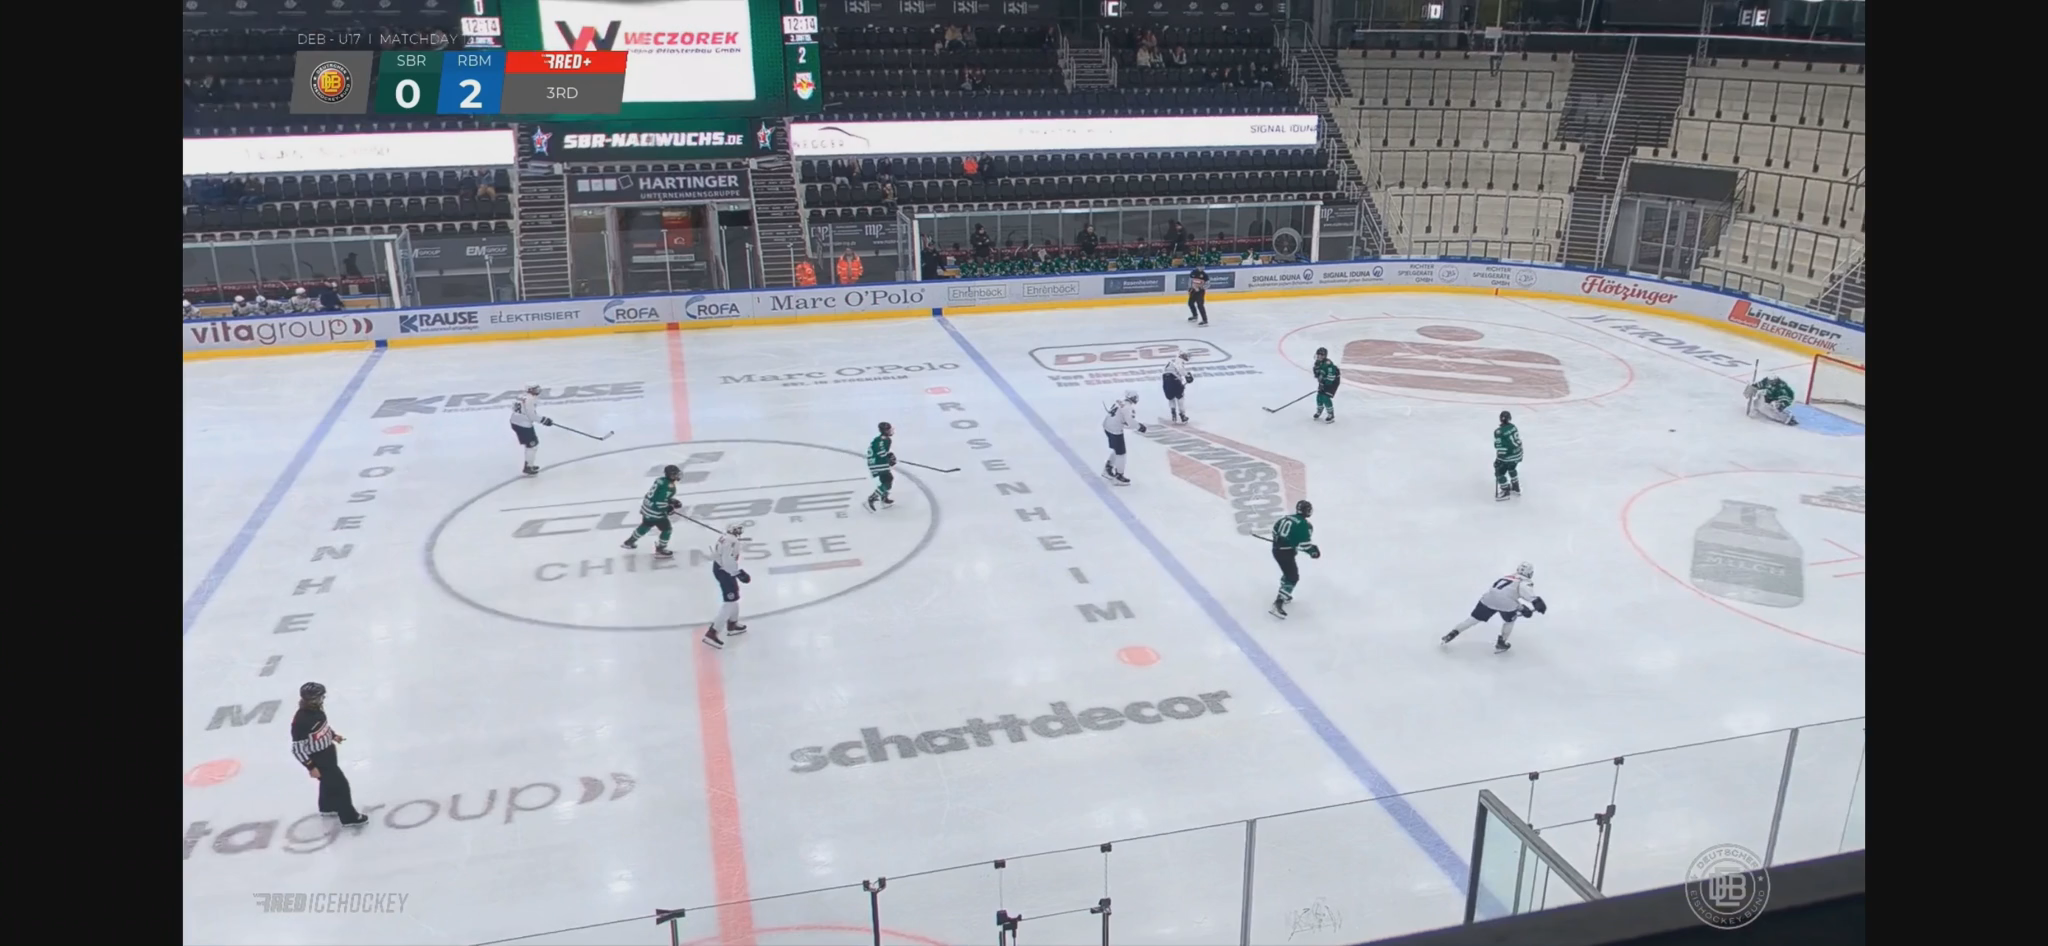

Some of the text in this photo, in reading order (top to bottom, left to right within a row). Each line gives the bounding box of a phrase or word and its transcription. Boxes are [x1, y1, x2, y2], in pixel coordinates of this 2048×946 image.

[624, 32, 739, 45] WECZOREK
[798, 47, 807, 64] 2
[1250, 125, 1286, 133] SIGNAL
[639, 175, 739, 190] HARTINGER
[640, 190, 740, 199] UNTERNEHMENSGRUPPE
[466, 245, 486, 256] EM
[1581, 275, 1678, 305] Flötzinger
[697, 303, 740, 316] ROFA
[770, 295, 836, 311] Marc
[490, 310, 581, 324] ELEKTRISIERT
[615, 308, 660, 320] ROFA
[399, 311, 479, 333] KRAUSE
[191, 319, 347, 345] vitagroup
[1760, 322, 1838, 352] ELEKTROTECHNIK
[719, 371, 826, 385] Marc
[1278, 519, 1292, 537] 10
[789, 690, 1232, 773] schattdecor
